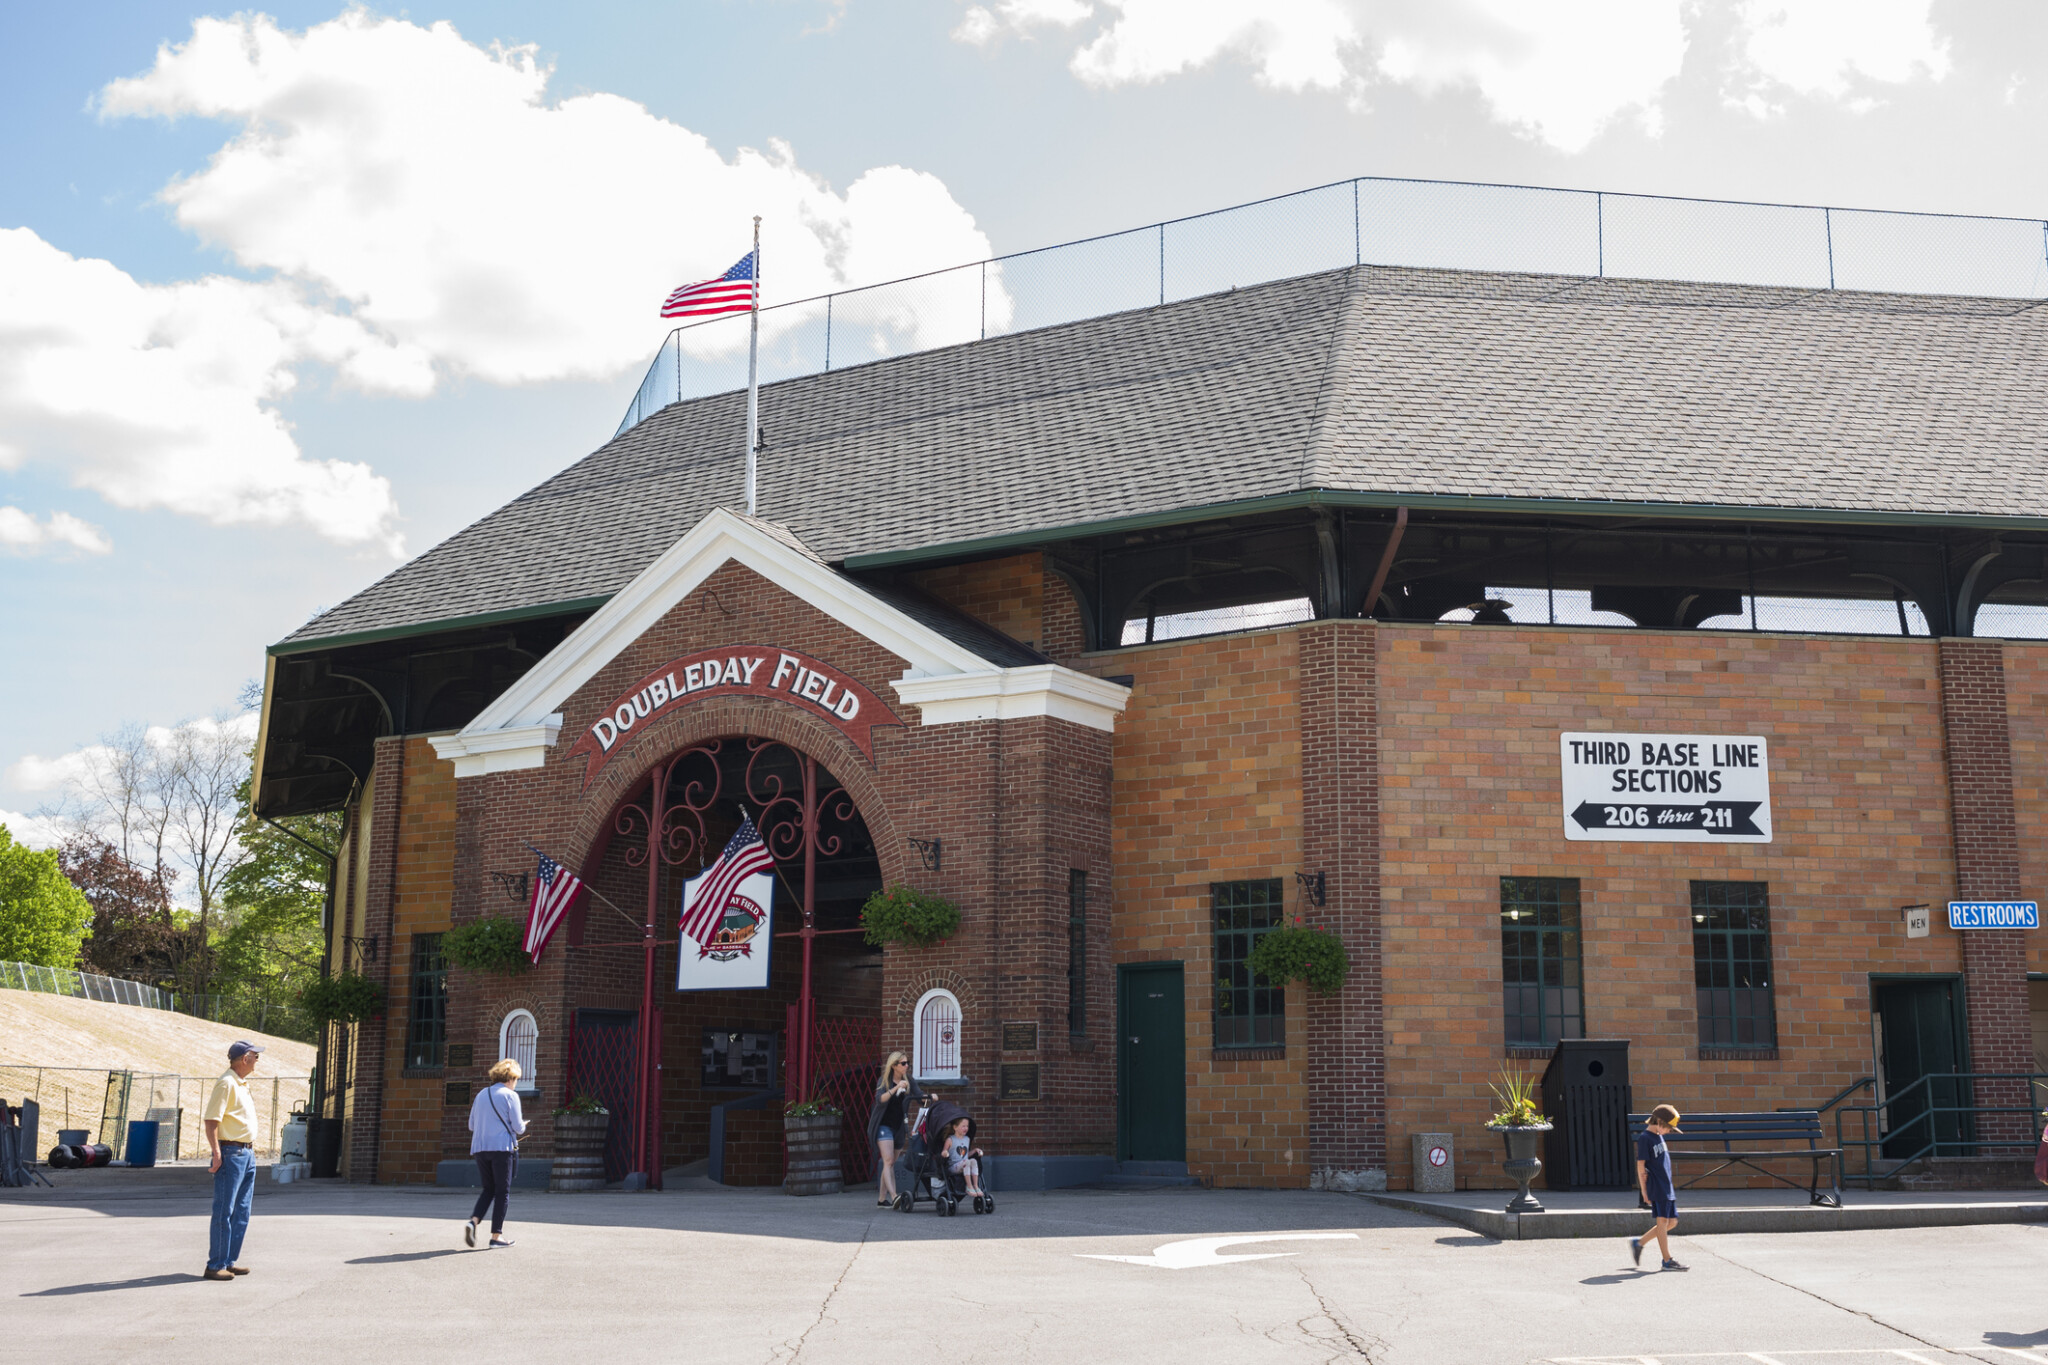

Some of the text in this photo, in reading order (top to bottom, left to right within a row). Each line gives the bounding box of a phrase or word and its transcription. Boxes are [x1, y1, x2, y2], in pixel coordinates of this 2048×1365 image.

[592, 653, 860, 753] DOUBLEDAY FIELD
[1569, 740, 1759, 768] THIRD BASE LINE
[1611, 768, 1722, 794] SECTIONS
[1603, 805, 1733, 828] 206 thru 211
[740, 897, 760, 915] FIELD
[1952, 904, 2035, 926] RESTROOMS
[1910, 917, 1926, 930] MEN
